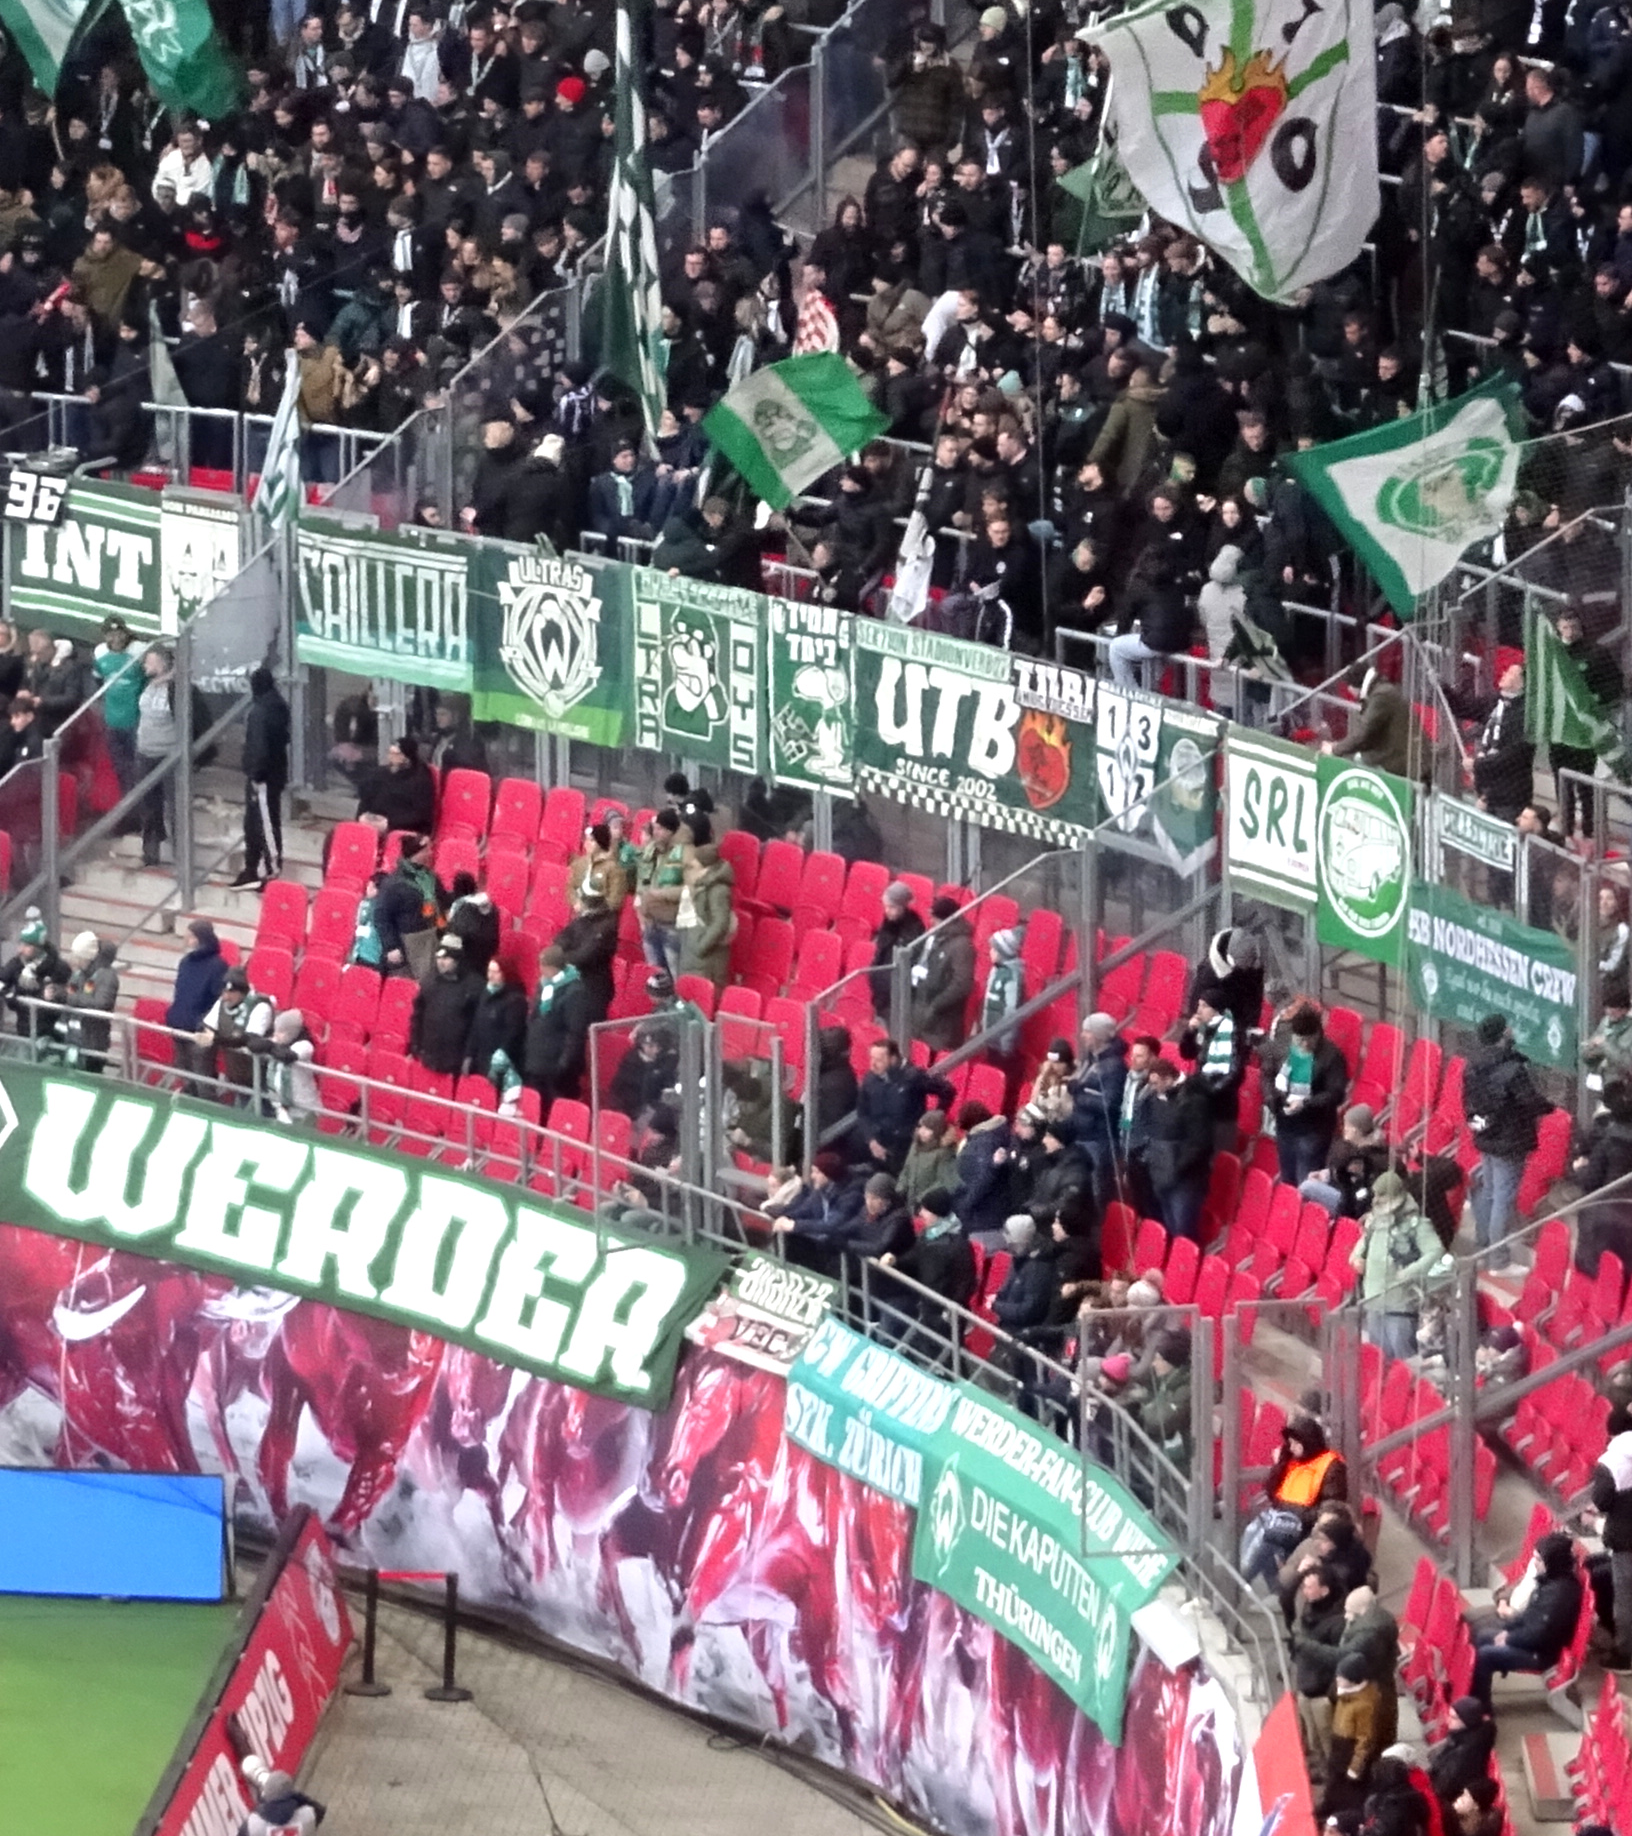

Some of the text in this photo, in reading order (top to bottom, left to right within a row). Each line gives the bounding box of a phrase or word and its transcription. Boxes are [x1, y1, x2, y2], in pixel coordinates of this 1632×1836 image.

[20, 521, 153, 601] INT
[517, 555, 585, 590] ULTRAS
[875, 655, 1021, 779] UTB
[894, 757, 999, 803] SINCE 2002
[1239, 767, 1308, 855] SRL
[1433, 916, 1530, 991] NORDHESSEN
[1531, 959, 1577, 1008] CREW
[21, 1076, 688, 1393] WERDER
[972, 1566, 1084, 1685] THÜRINGEN
